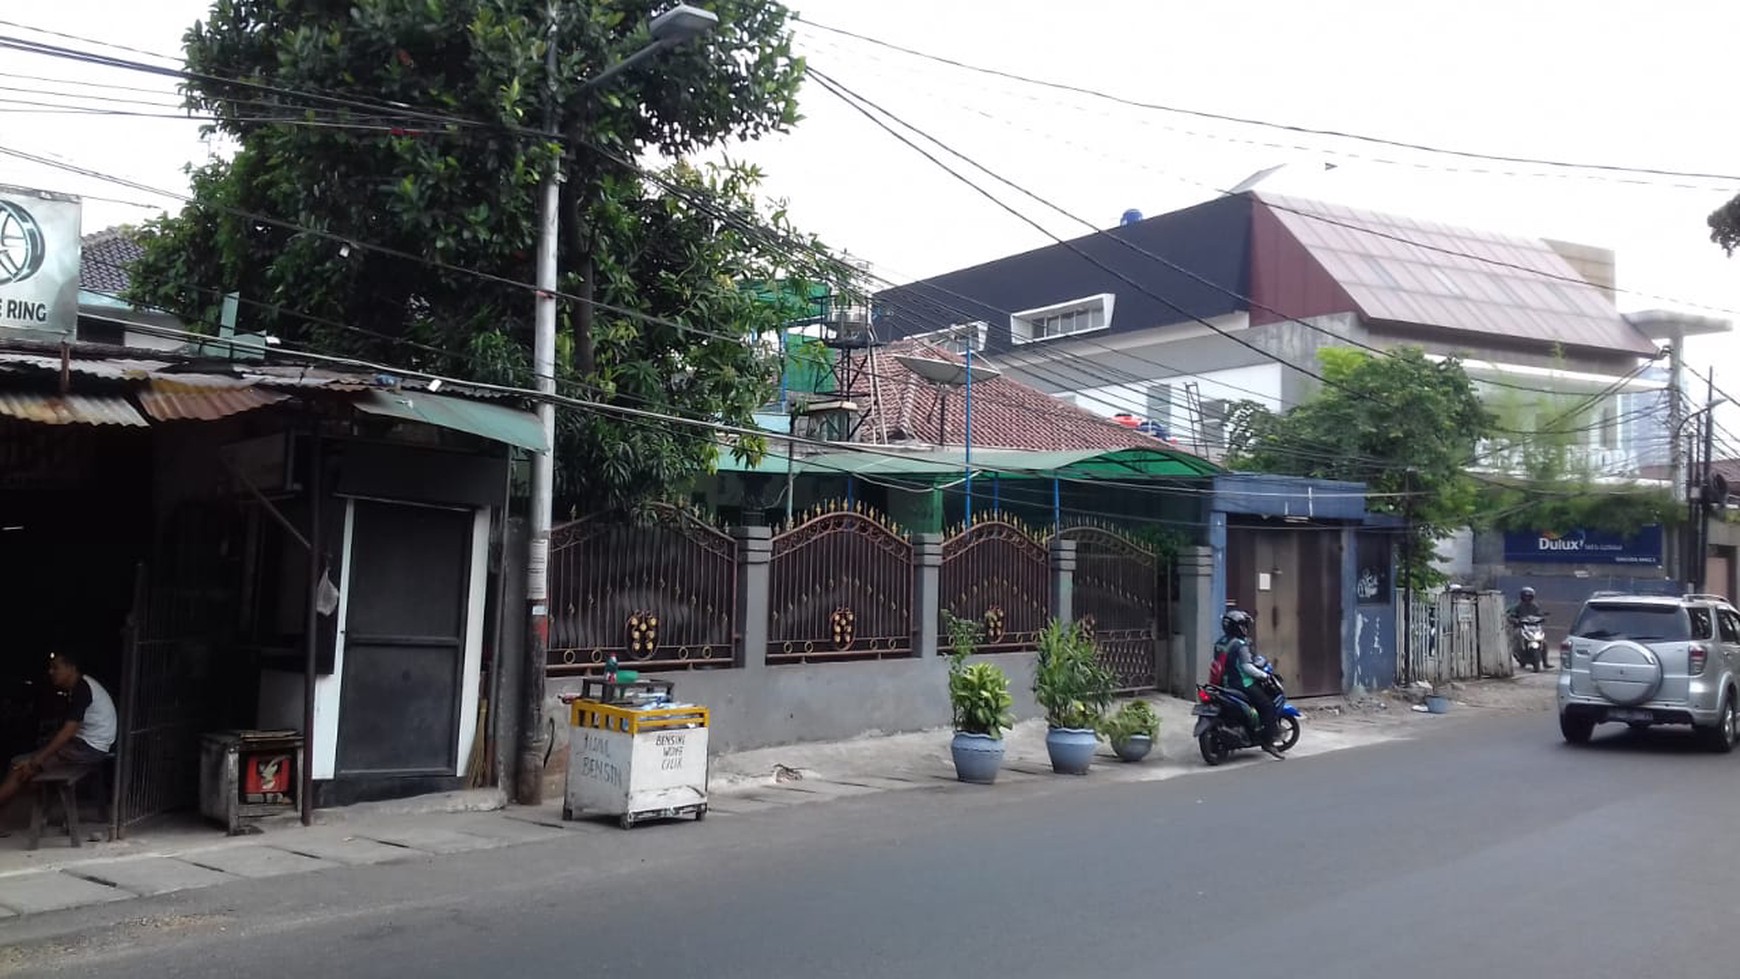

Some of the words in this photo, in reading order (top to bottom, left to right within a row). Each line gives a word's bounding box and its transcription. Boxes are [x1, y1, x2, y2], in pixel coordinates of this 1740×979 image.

[7, 299, 47, 321] RING
[1539, 538, 1580, 551] Dulux
[581, 756, 622, 789] BENSIN
